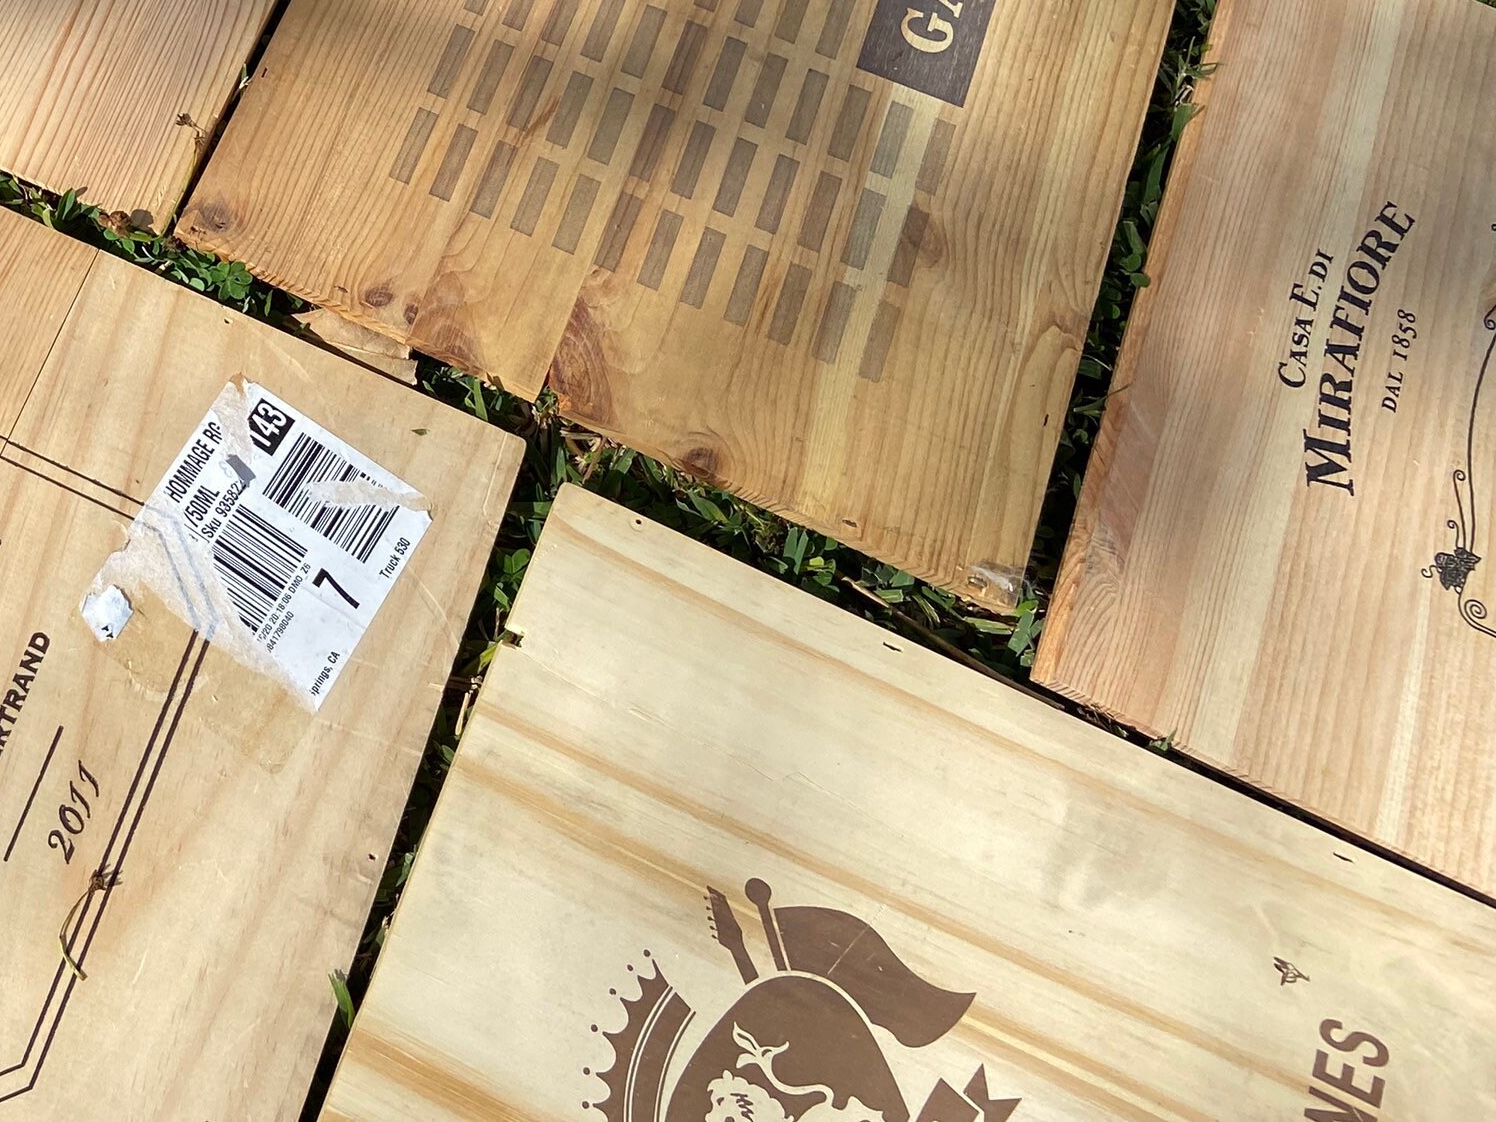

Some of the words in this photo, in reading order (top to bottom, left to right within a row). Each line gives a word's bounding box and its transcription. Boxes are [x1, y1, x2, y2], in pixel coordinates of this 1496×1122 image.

[1277, 316, 1314, 389] CASA
[1303, 200, 1416, 496] MIRAFIORE
[1391, 308, 1418, 361] 1858
[1381, 371, 1404, 414] DAL
[165, 438, 215, 504] HOMMAGE
[201, 518, 222, 539] Sku
[378, 554, 401, 579] Truck
[311, 567, 360, 610] 7
[266, 610, 294, 653] 841798040
[327, 651, 341, 664] CA
[47, 759, 101, 866] 2011
